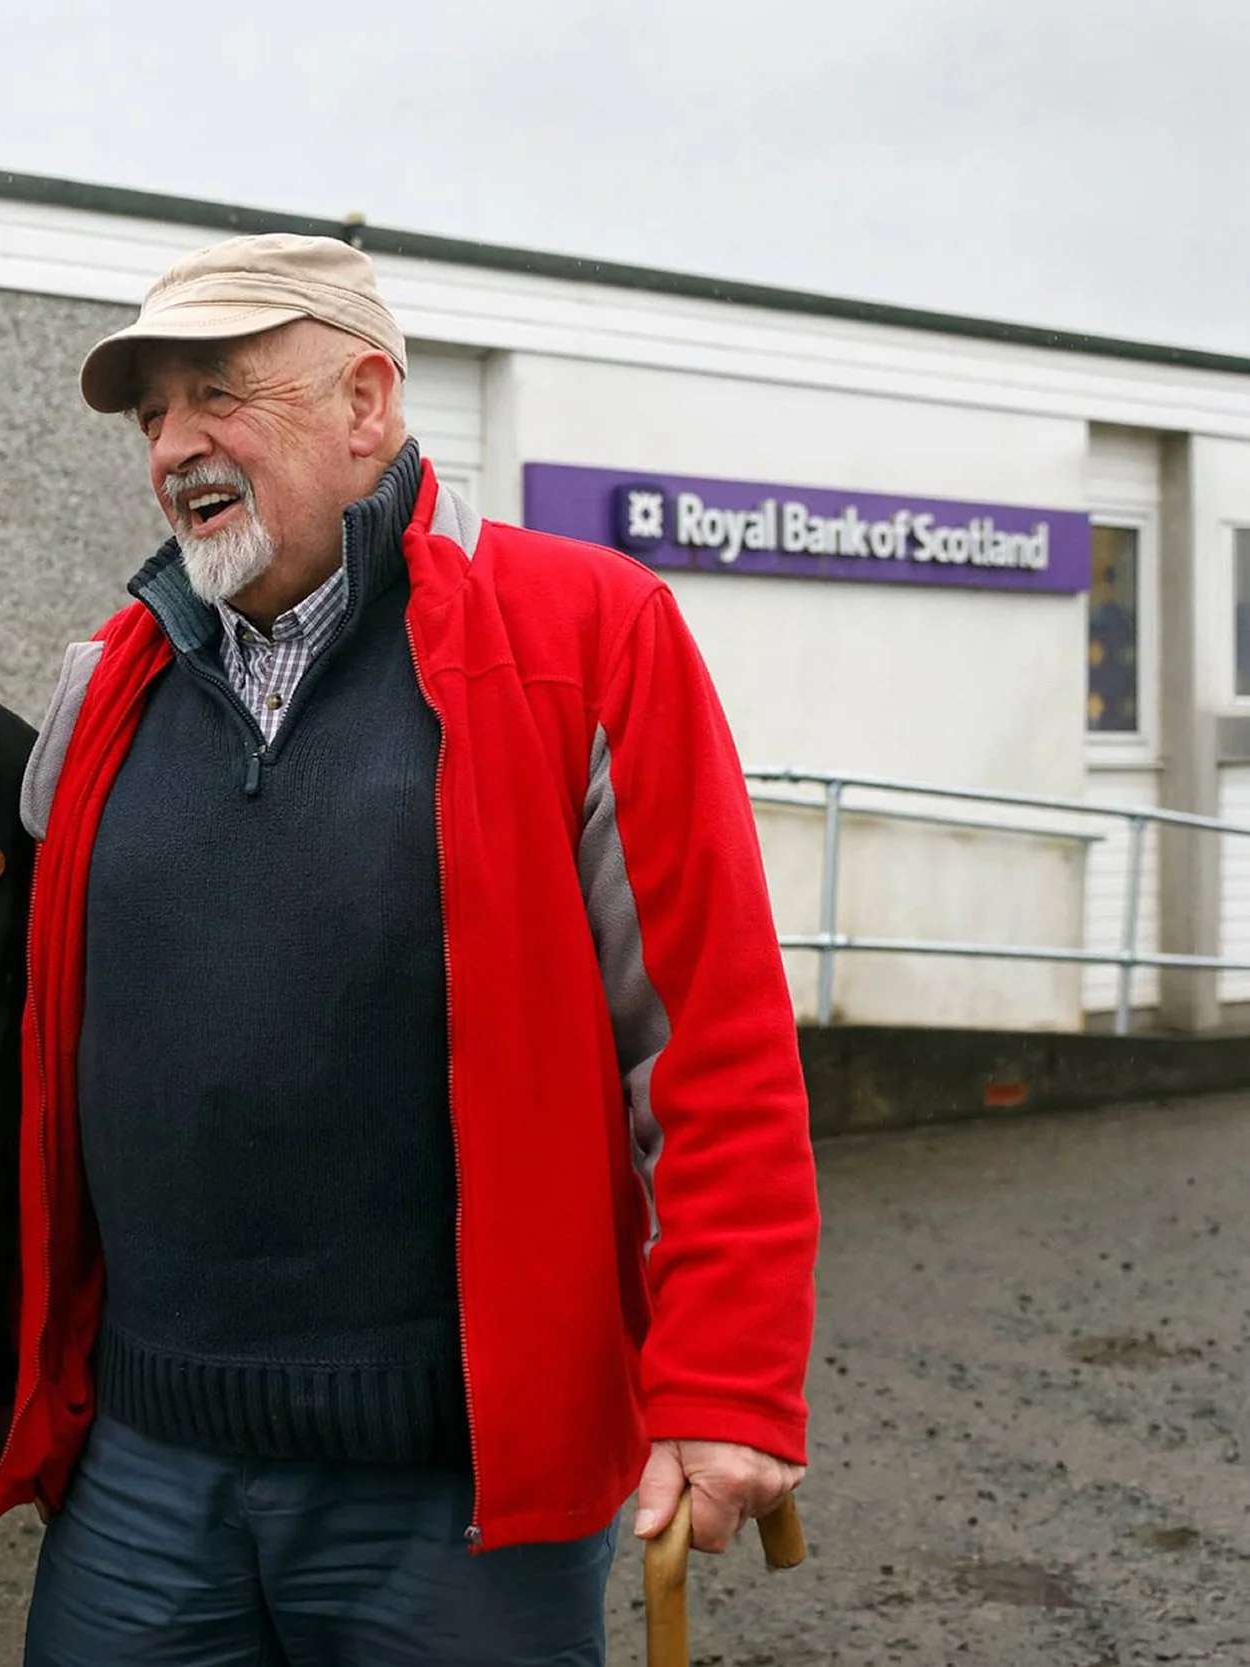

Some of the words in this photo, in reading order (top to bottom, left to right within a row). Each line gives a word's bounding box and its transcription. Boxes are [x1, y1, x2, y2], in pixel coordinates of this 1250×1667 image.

[677, 492, 778, 563] Royal
[782, 501, 869, 557] Bank
[870, 509, 911, 560] of
[912, 512, 1049, 571] Scotland
